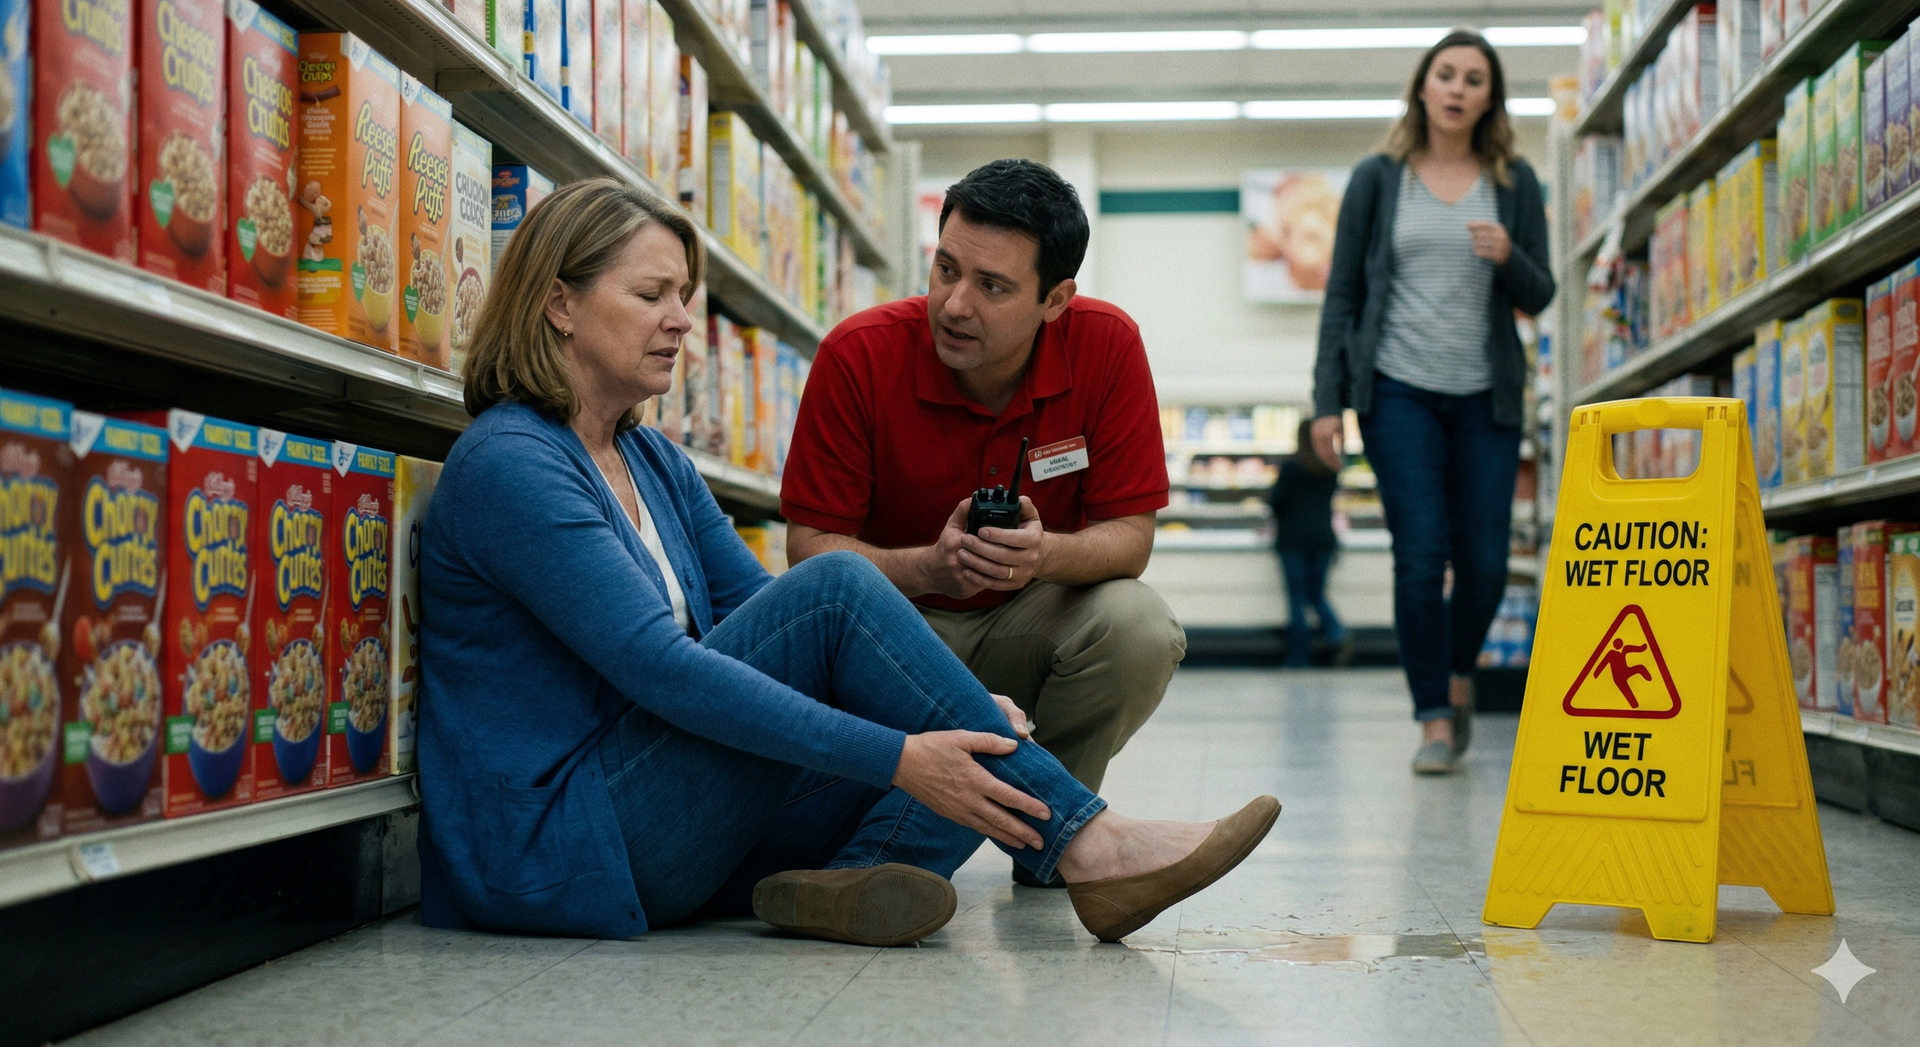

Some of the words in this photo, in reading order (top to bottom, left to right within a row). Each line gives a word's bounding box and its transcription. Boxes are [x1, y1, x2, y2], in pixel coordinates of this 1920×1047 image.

[355, 102, 397, 161] Reese's
[362, 147, 392, 198] Puffs
[408, 132, 449, 188] Reese's
[413, 175, 445, 223] Puffs
[1574, 520, 1708, 551] CAUTION:
[1565, 560, 1619, 587] WET
[1624, 559, 1710, 586] FLOOR
[1584, 731, 1652, 761] WET
[1559, 765, 1667, 798] FLOOR
